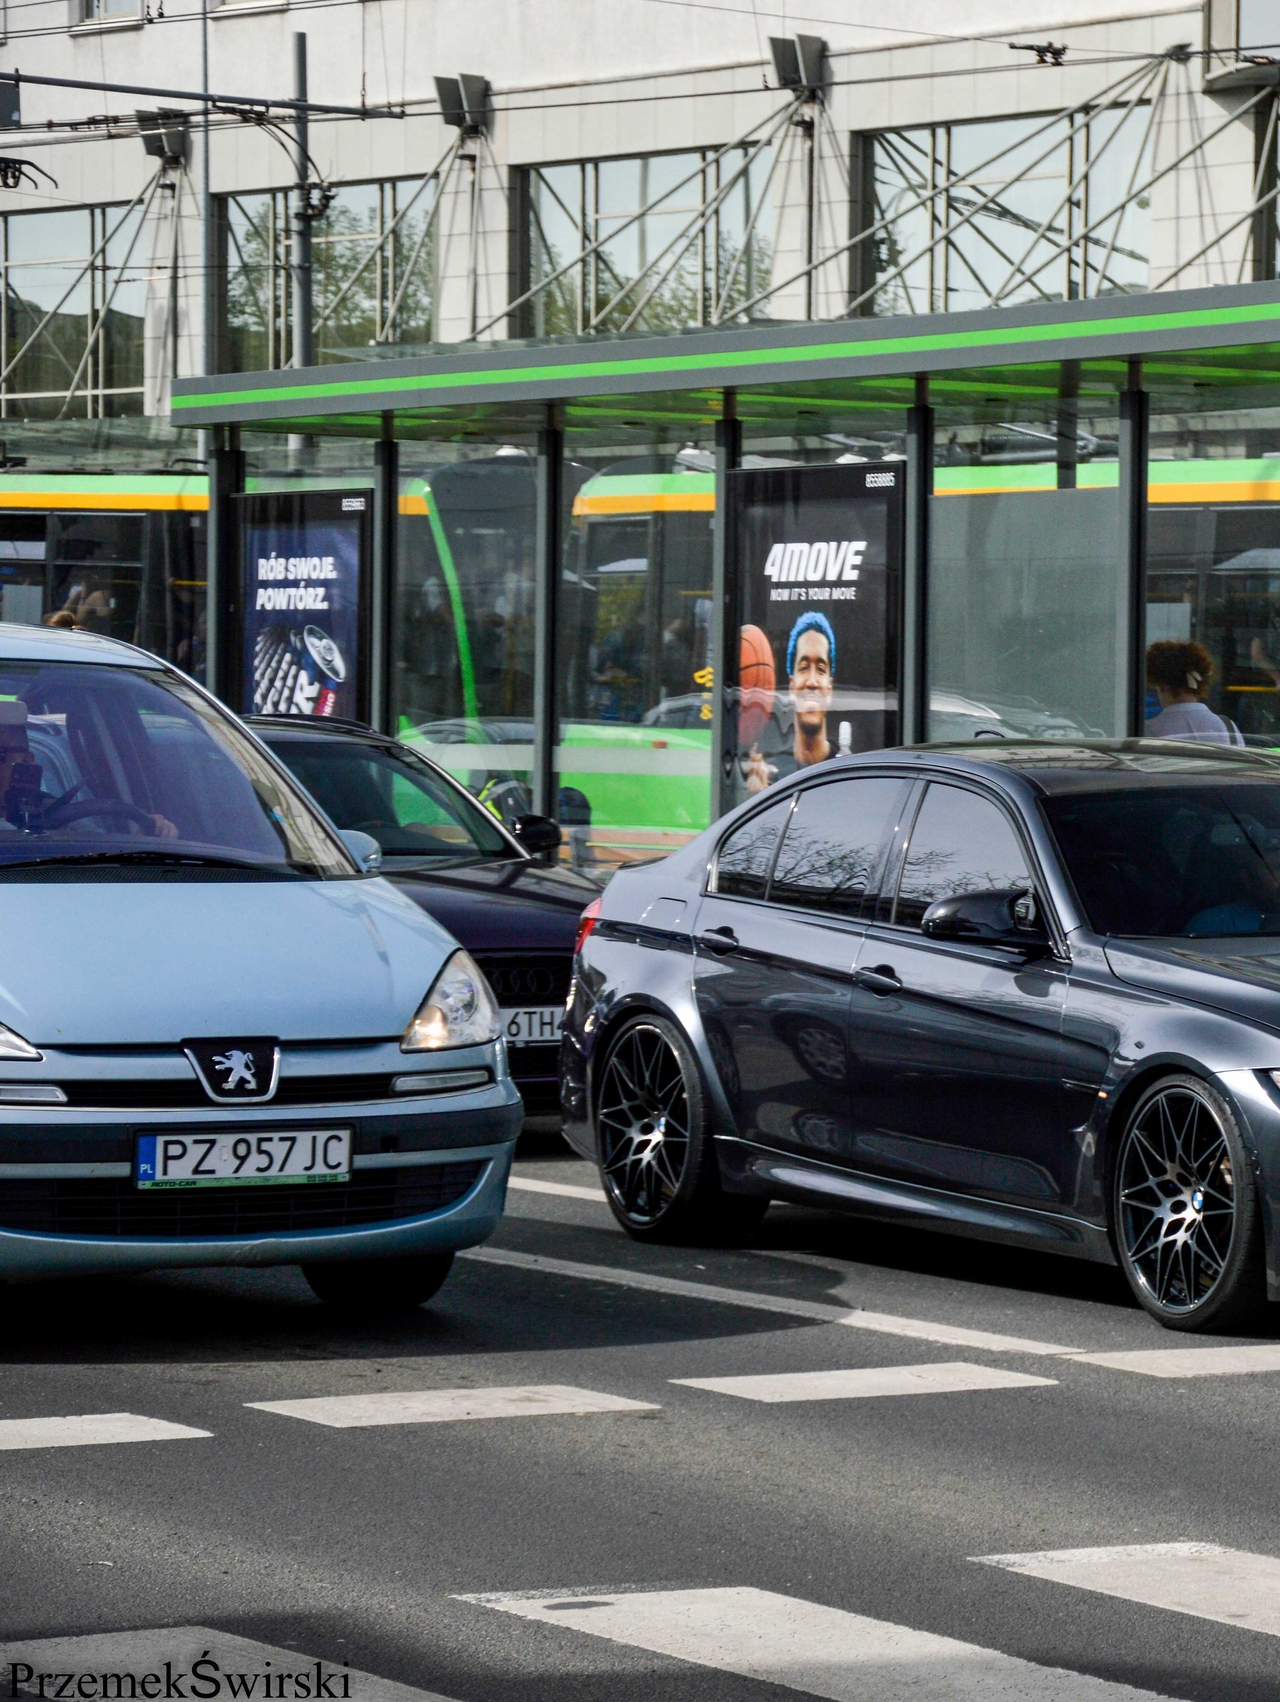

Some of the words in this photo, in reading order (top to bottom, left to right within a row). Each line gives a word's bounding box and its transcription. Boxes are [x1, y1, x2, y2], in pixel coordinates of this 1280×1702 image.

[257, 551, 287, 581] RÓB
[286, 556, 338, 580] SWOJE.
[763, 540, 868, 582] 4MOVE
[255, 580, 329, 611] POWTÓRZ.
[769, 588, 791, 601] NOW
[807, 587, 831, 600] YOUR
[831, 586, 857, 600] MOVE
[140, 1163, 153, 1174] PL
[162, 1138, 218, 1177] PZ
